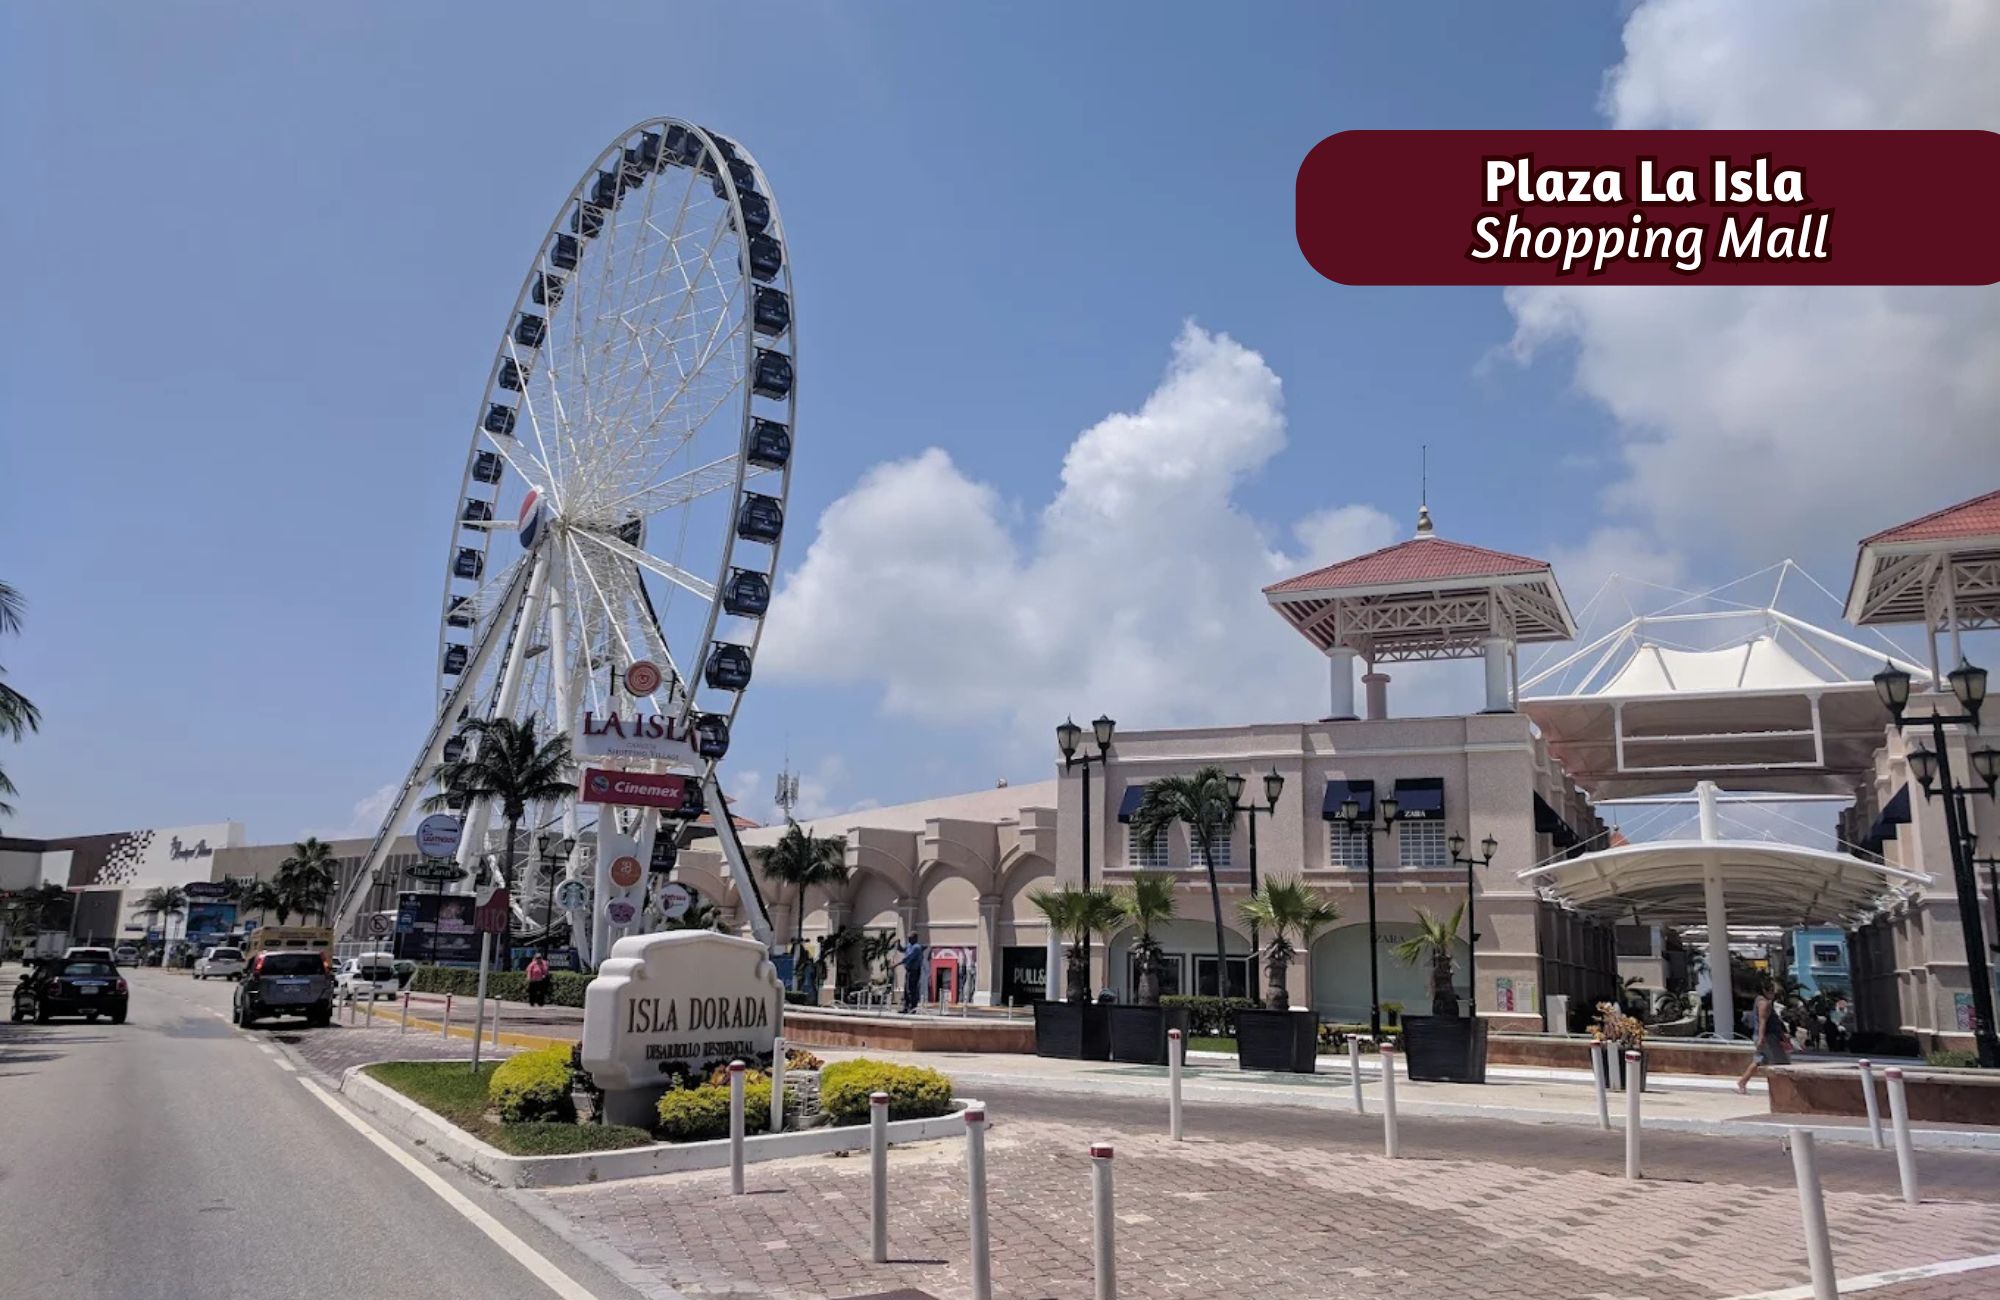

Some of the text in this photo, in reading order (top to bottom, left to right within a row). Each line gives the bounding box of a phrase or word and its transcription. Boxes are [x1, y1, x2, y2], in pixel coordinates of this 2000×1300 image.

[583, 711, 700, 753] LA ISLA
[614, 781, 680, 798] Cinemex
[1404, 810, 1426, 818] ZARA
[1376, 934, 1406, 944] ZARA
[627, 996, 768, 1033] ISLA DORADA
[646, 1040, 754, 1060] DESARROLLO RESIDENCIAL
